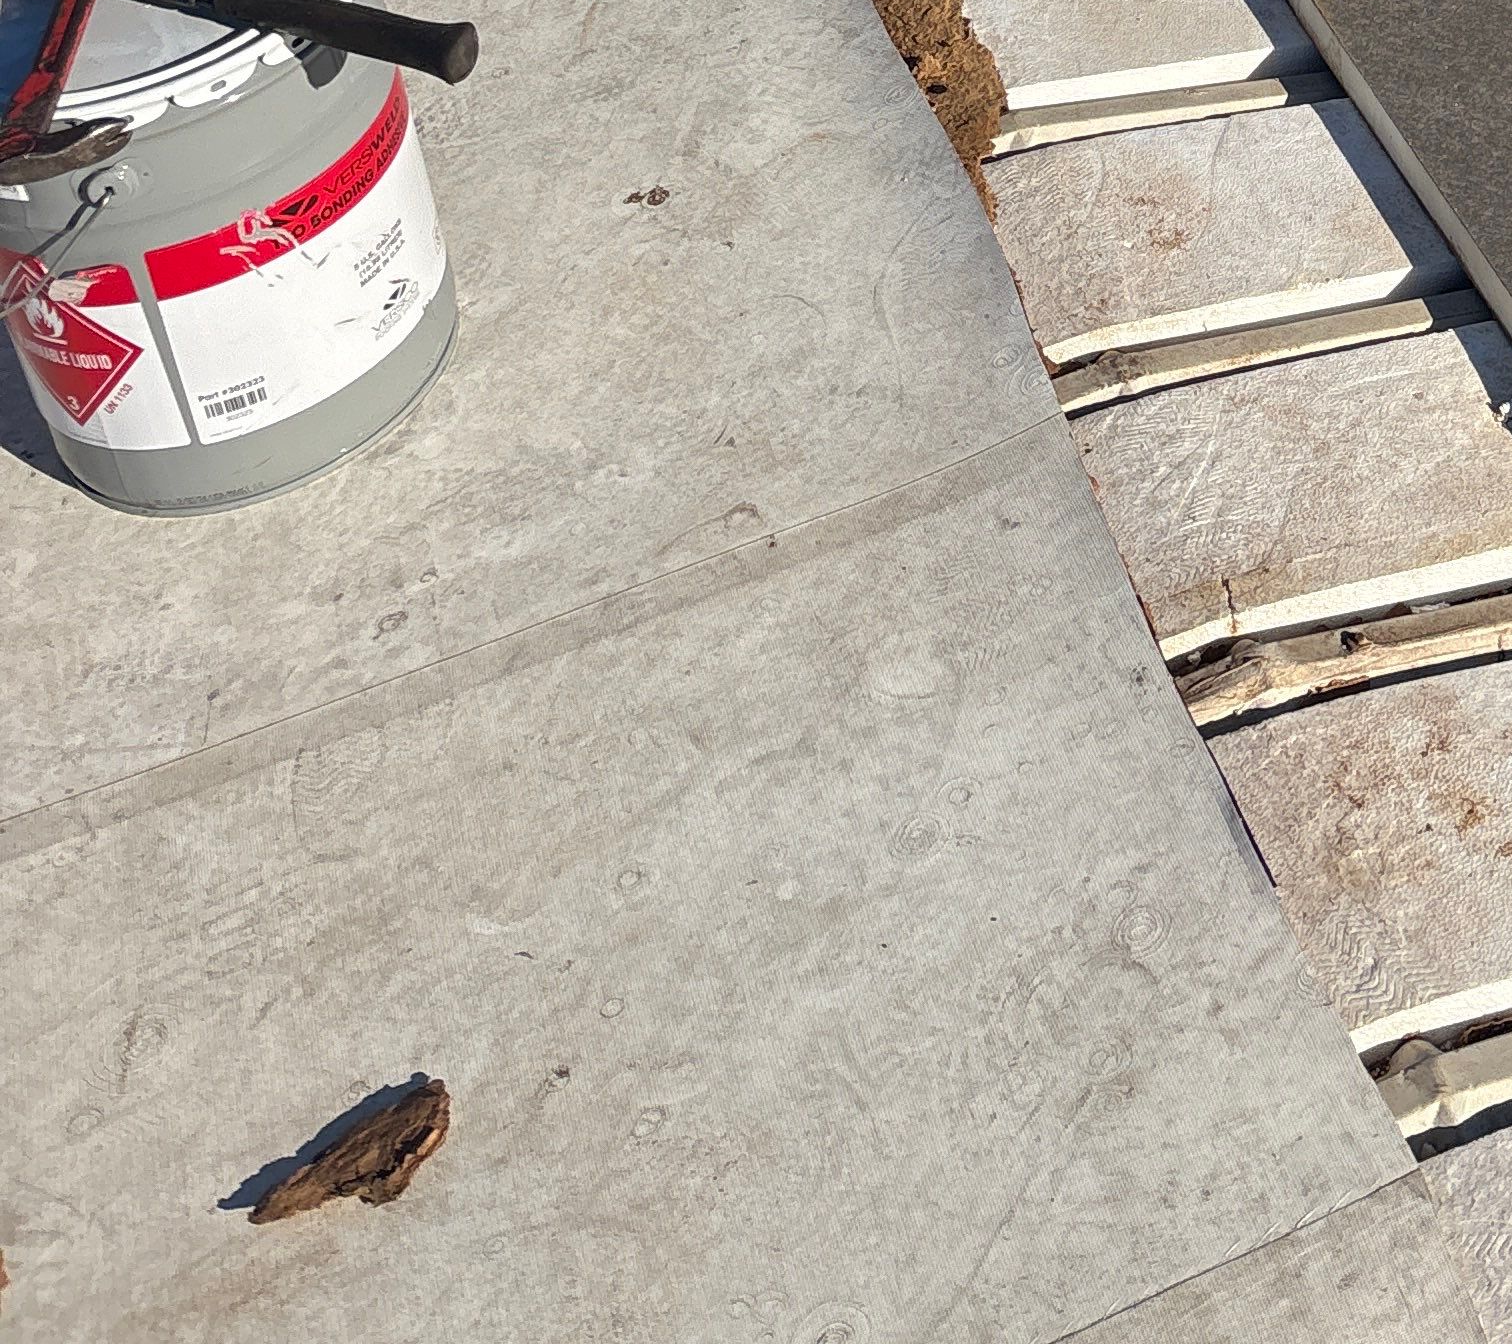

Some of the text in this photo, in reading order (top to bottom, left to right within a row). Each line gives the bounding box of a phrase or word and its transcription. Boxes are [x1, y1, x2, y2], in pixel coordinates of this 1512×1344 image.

[323, 96, 400, 194] VERSIWELD
[310, 168, 374, 228] BONDING
[70, 351, 112, 370] LIQUID
[67, 395, 80, 410] 3
[104, 383, 134, 414] UN 1133
[198, 391, 219, 402] Part
